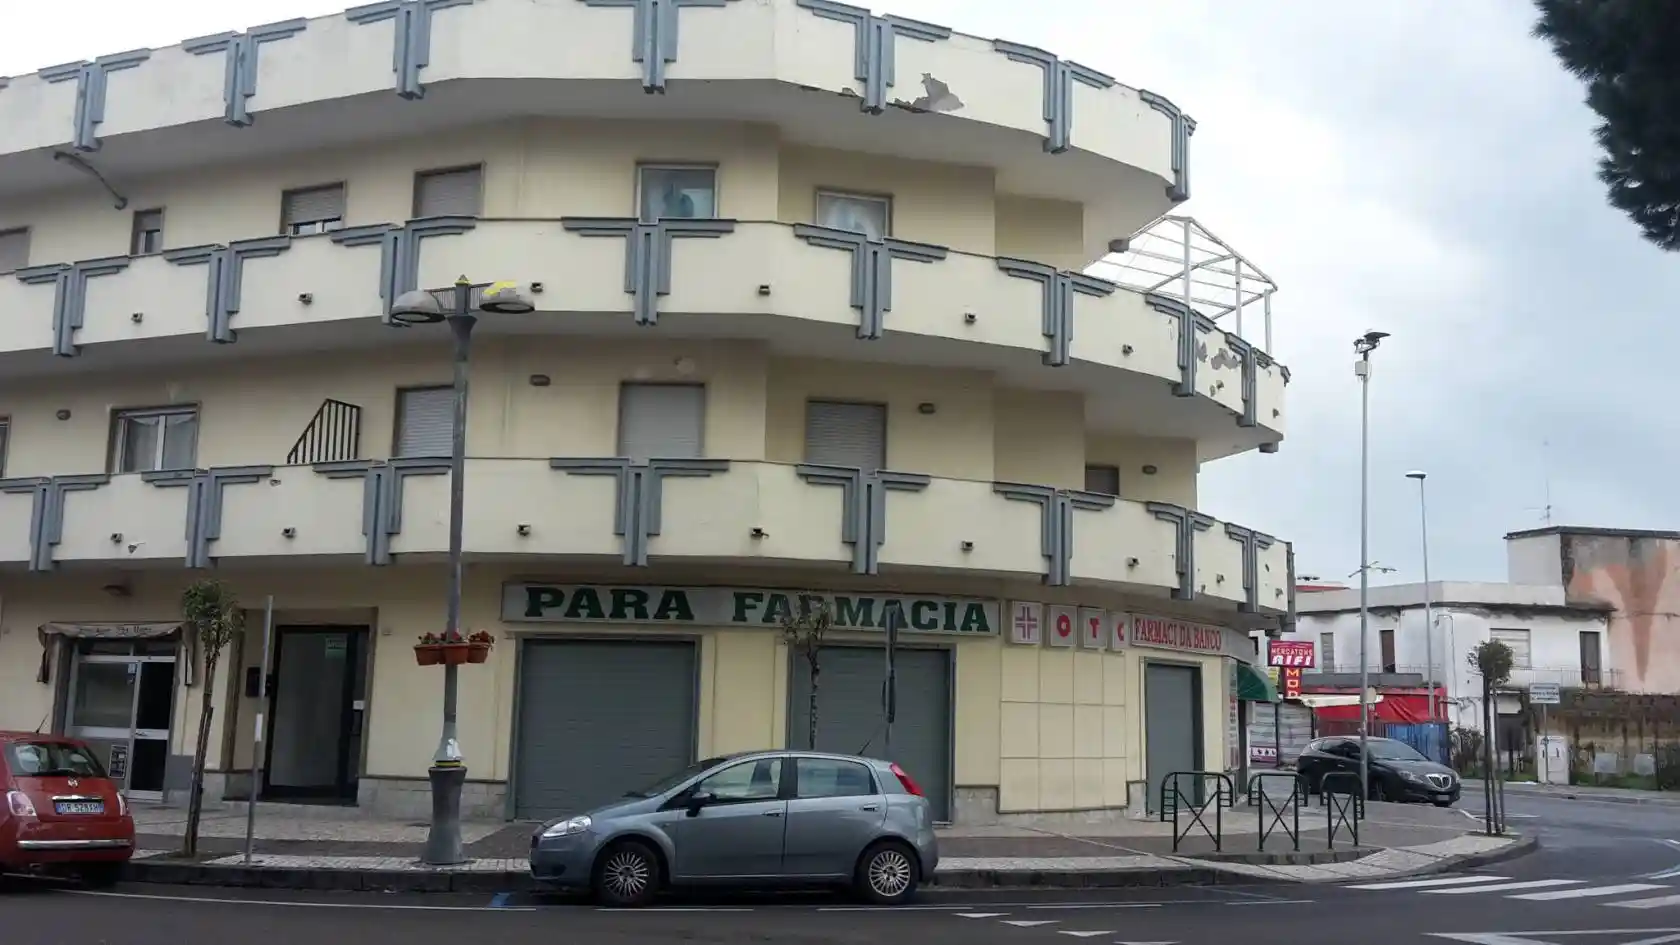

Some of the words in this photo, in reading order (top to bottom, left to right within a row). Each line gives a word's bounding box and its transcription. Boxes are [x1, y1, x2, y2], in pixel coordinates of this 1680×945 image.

[524, 586, 695, 621] PARA
[1134, 617, 1177, 646] FARMACI
[1179, 623, 1192, 648] DA
[1193, 626, 1222, 651] BANCO
